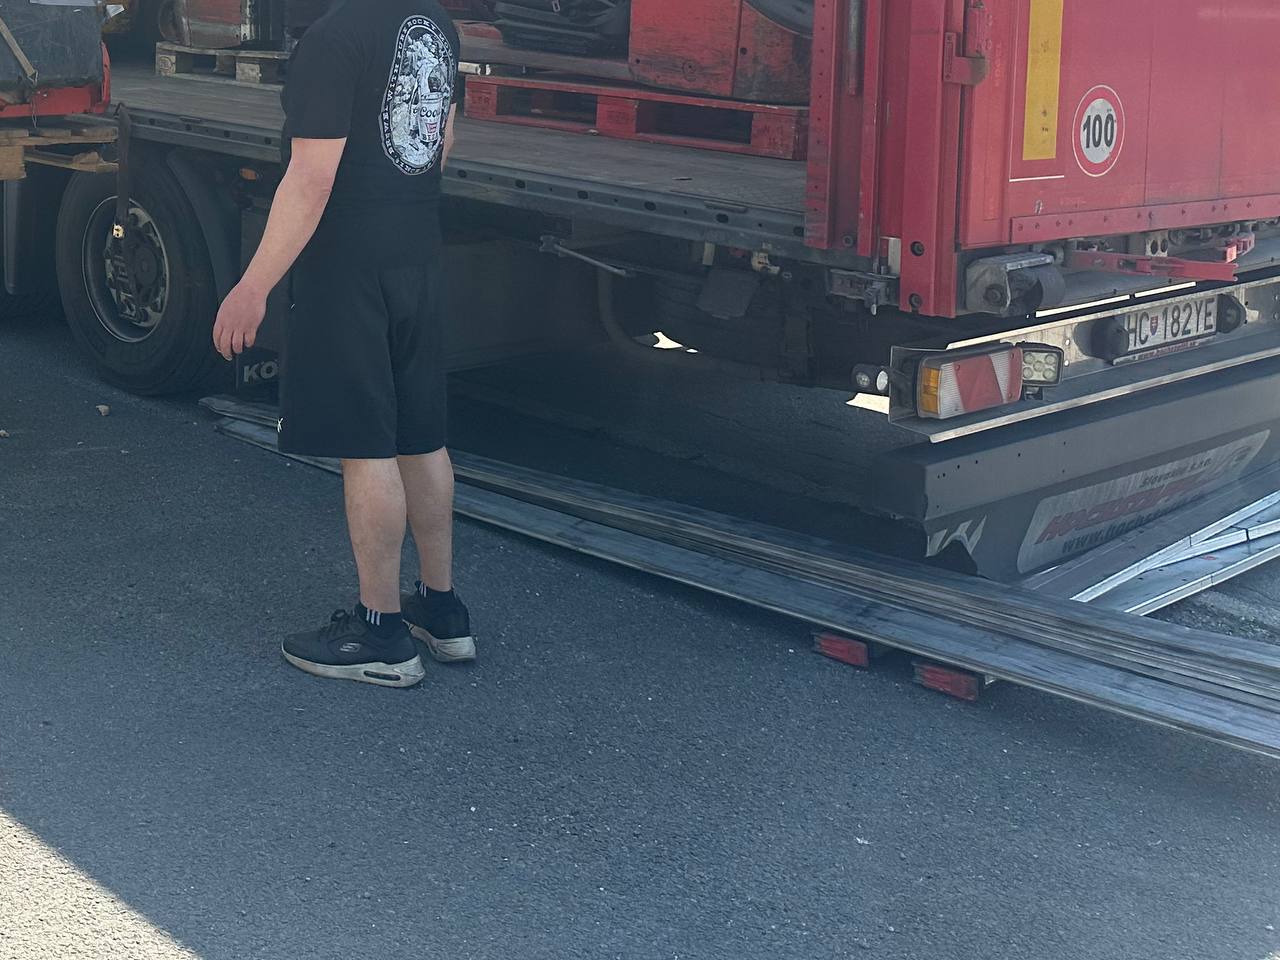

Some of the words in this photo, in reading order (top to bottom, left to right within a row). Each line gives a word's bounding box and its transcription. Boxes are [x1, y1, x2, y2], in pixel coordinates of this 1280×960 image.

[407, 19, 437, 31] ROCKY
[1083, 113, 1115, 148] 100
[1127, 312, 1150, 347] HC
[1162, 298, 1215, 341] 182YE
